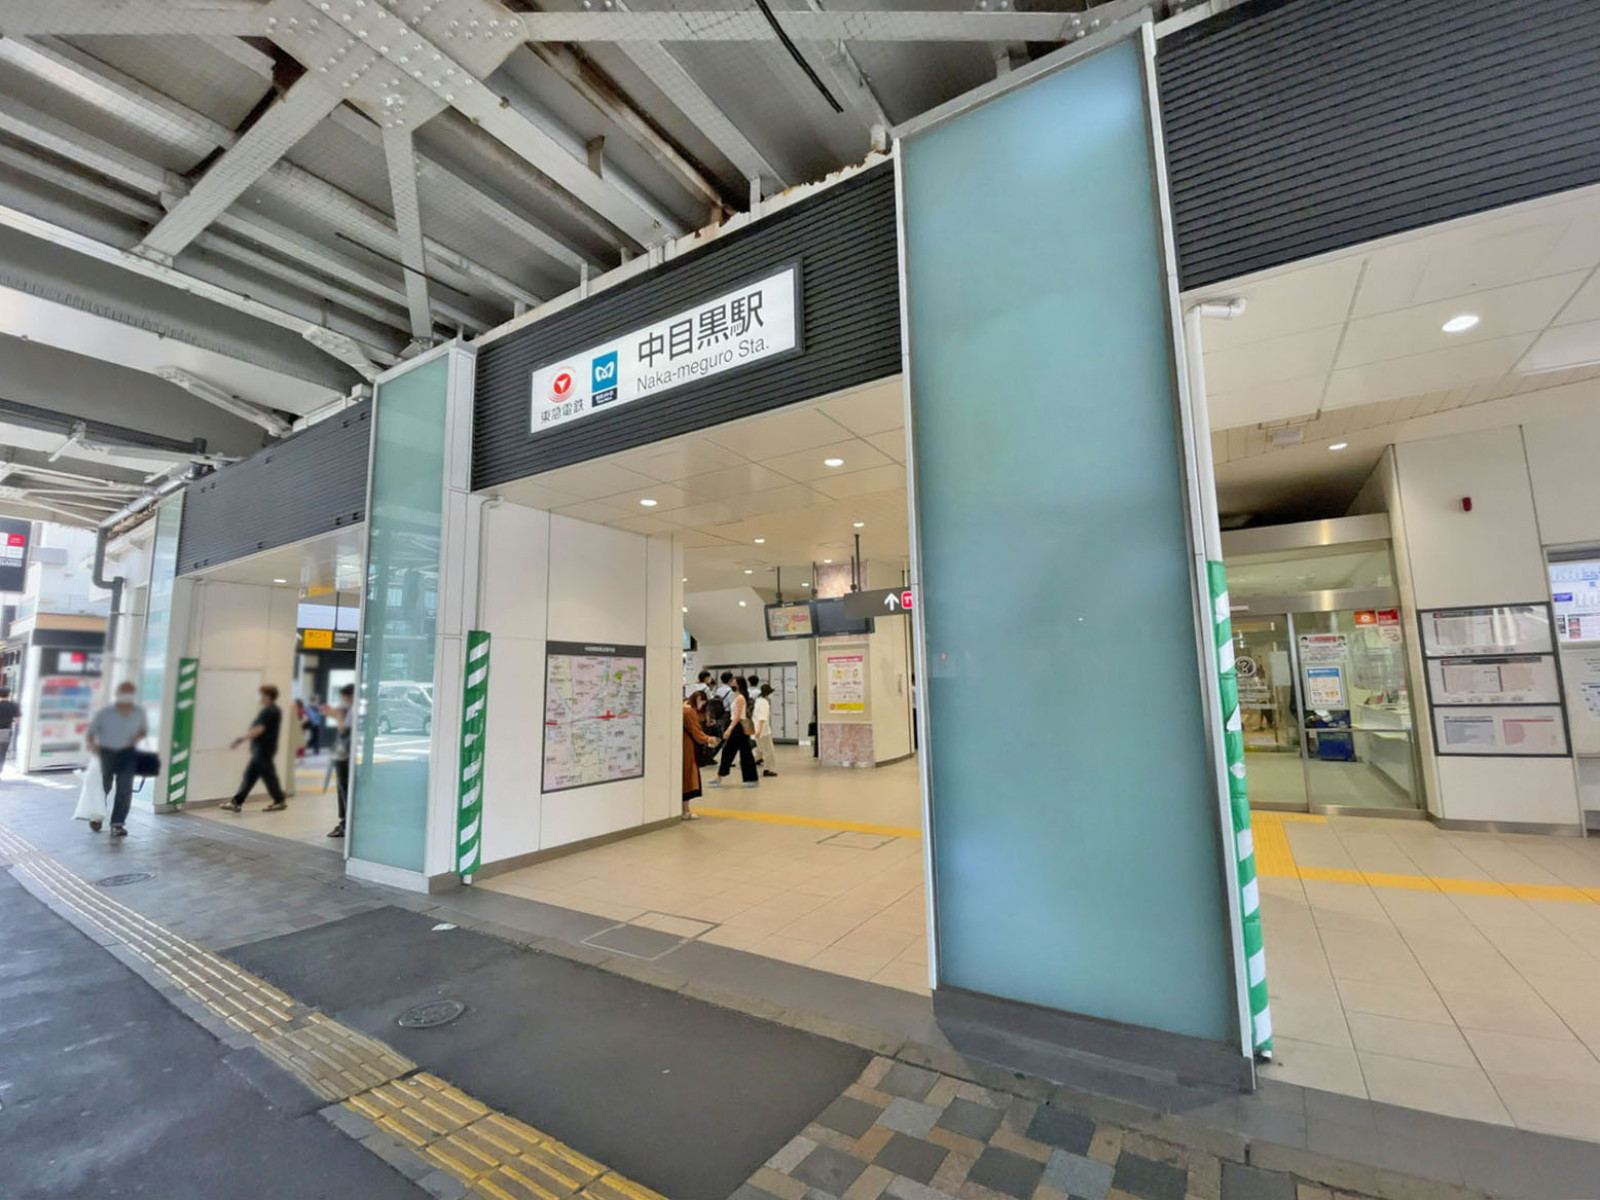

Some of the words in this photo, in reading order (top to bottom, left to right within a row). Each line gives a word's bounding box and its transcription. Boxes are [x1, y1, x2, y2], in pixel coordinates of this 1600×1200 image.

[638, 290, 764, 368] 中目黒駅
[636, 349, 733, 393] Naka-meguro
[738, 338, 769, 358] Sta.
[541, 398, 584, 424] 東急電鉄
